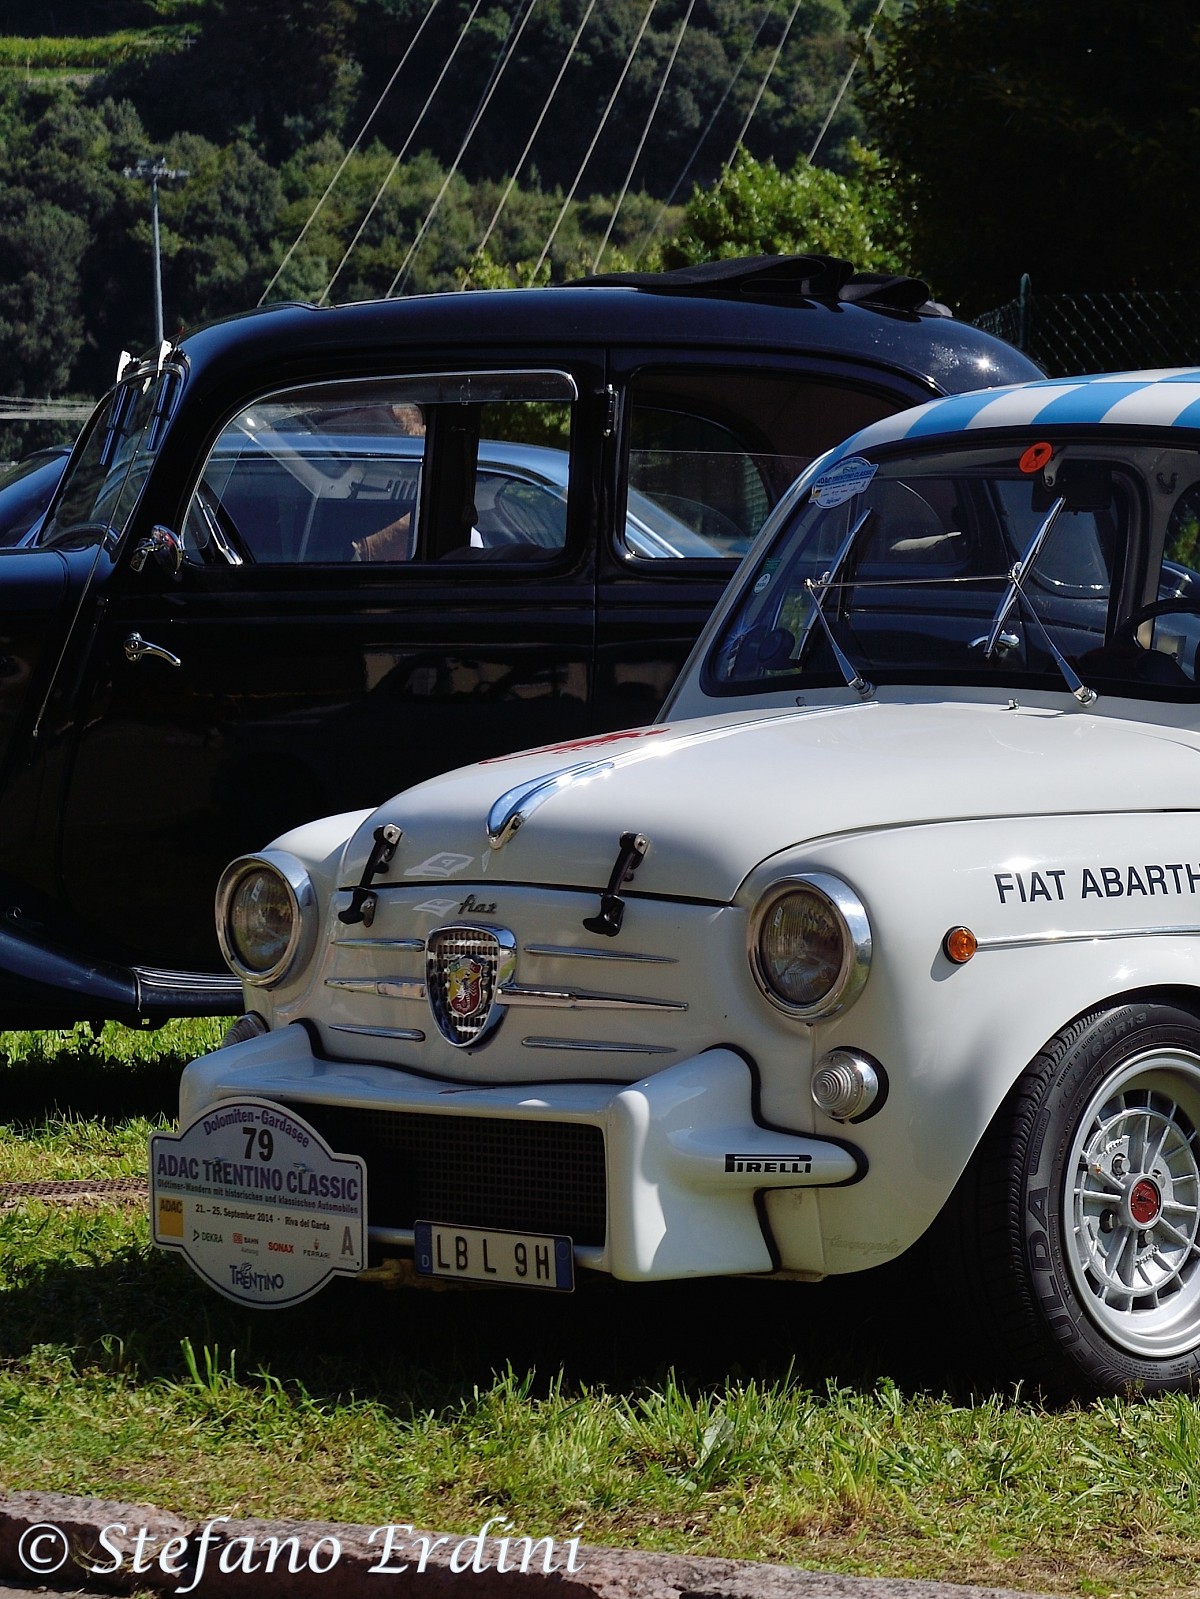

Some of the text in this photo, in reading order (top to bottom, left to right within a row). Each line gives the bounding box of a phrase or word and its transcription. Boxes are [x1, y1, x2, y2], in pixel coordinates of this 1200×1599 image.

[994, 869, 1065, 904] FIAT
[242, 1126, 274, 1162] 79
[725, 1154, 812, 1174] PIRELLI
[157, 1153, 358, 1201] ADAC TRENTINO CLASSIC
[157, 1179, 359, 1214] Oldtimer-Wandern mit historischen und klassischen Automobilen
[160, 1198, 183, 1215] ADAC
[223, 1208, 256, 1221] September
[257, 1212, 274, 1223] 2014
[285, 1216, 299, 1227] Riva
[300, 1219, 310, 1229] del
[311, 1221, 330, 1231] Garda
[202, 1232, 223, 1244] DEKRA
[268, 1242, 294, 1254] SONAX
[341, 1226, 354, 1256] A
[303, 1249, 331, 1259] FERRARI
[421, 1254, 430, 1268] D
[514, 1242, 550, 1280] 9H
